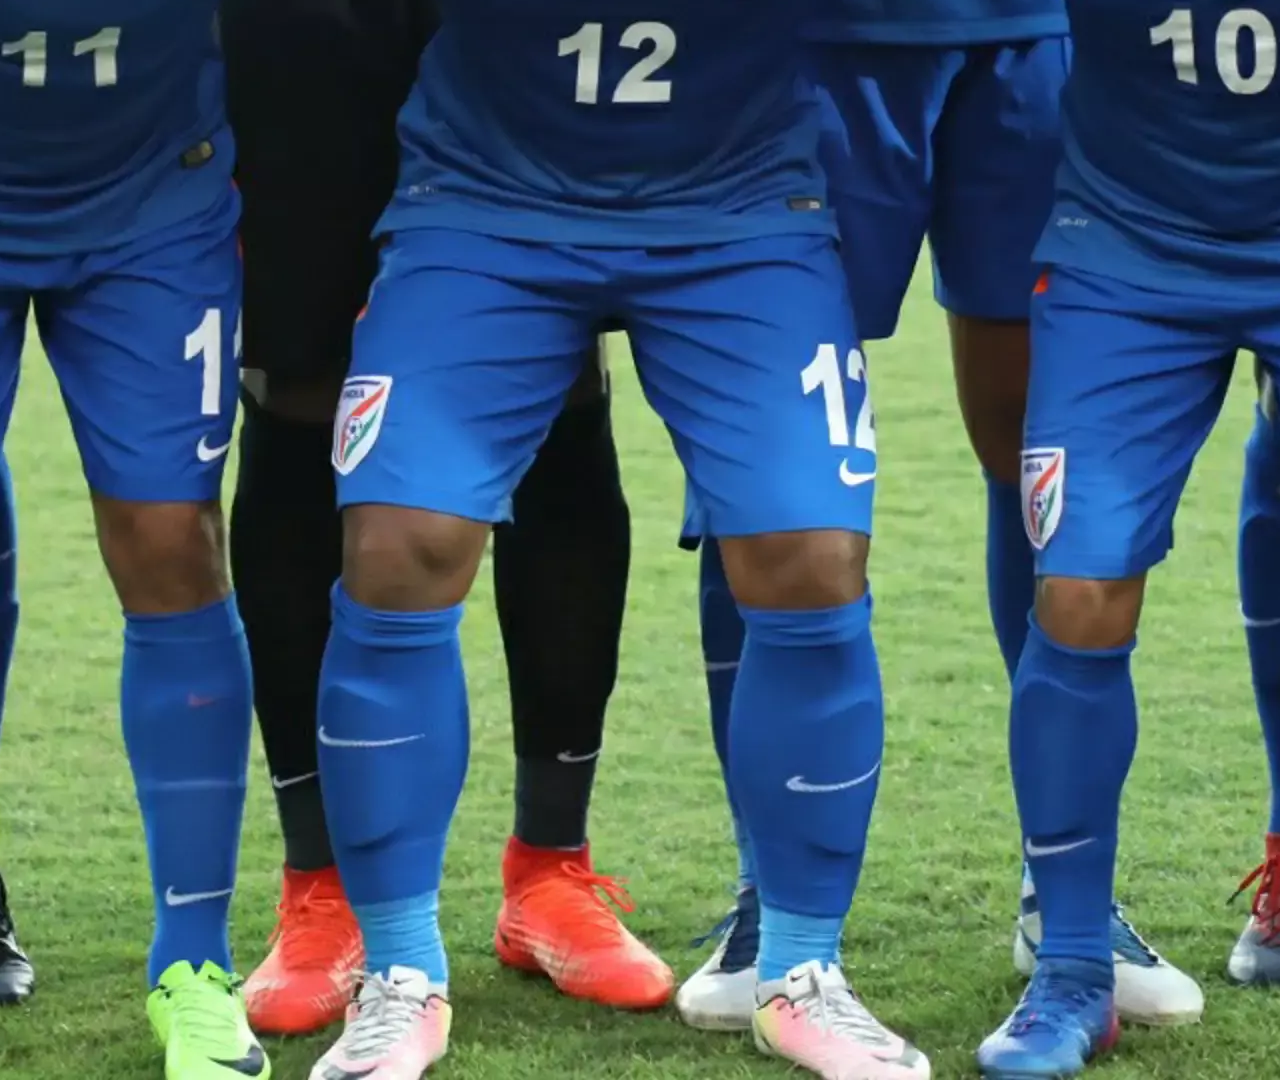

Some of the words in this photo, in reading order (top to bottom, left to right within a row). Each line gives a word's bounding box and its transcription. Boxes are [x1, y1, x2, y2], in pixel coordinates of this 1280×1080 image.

[1, 27, 120, 87] 11
[557, 21, 677, 104] 12
[1149, 9, 1277, 94] 10
[800, 343, 876, 452] 12
